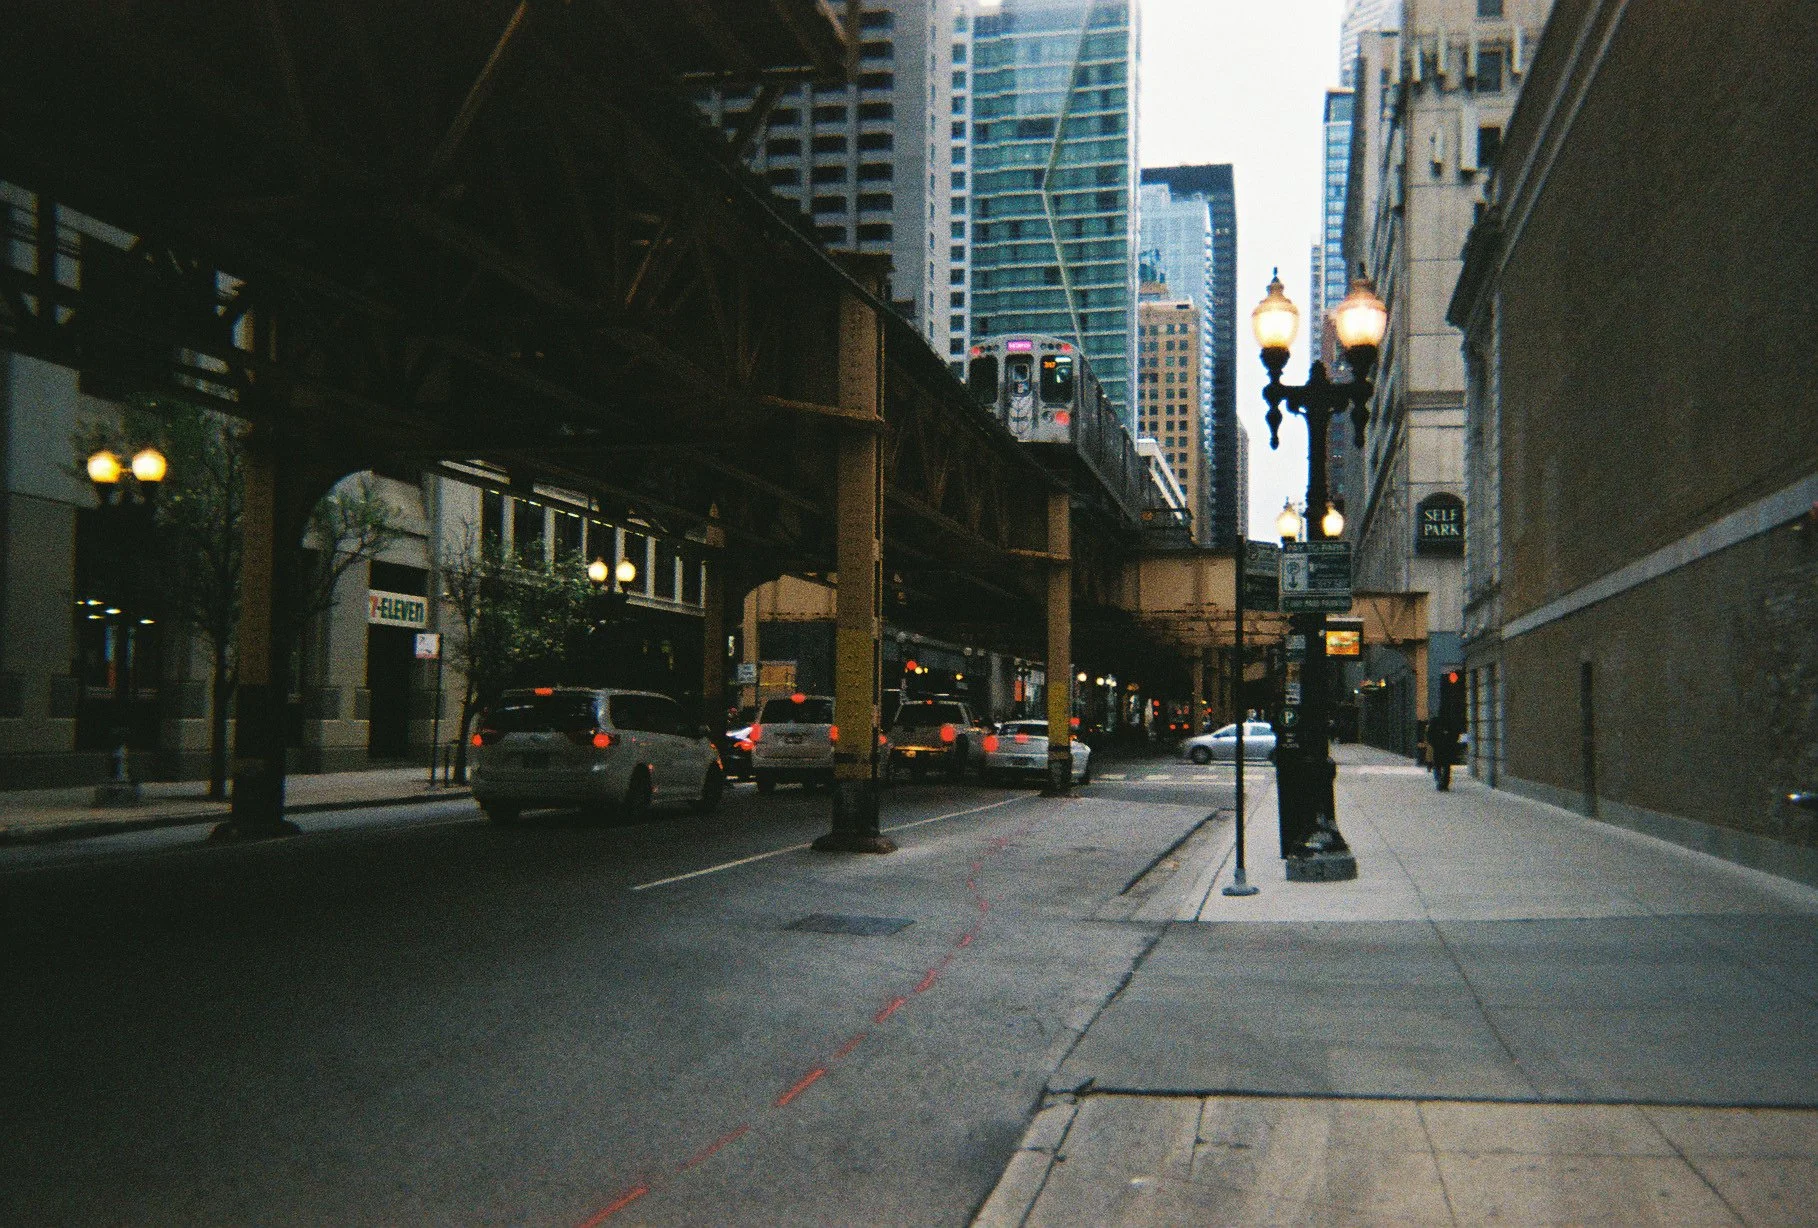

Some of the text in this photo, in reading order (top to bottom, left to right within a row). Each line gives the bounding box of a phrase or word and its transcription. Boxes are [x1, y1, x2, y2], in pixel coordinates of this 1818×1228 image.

[1424, 509, 1458, 521] SELF
[1424, 523, 1460, 536] PARK
[1284, 711, 1294, 724] P
